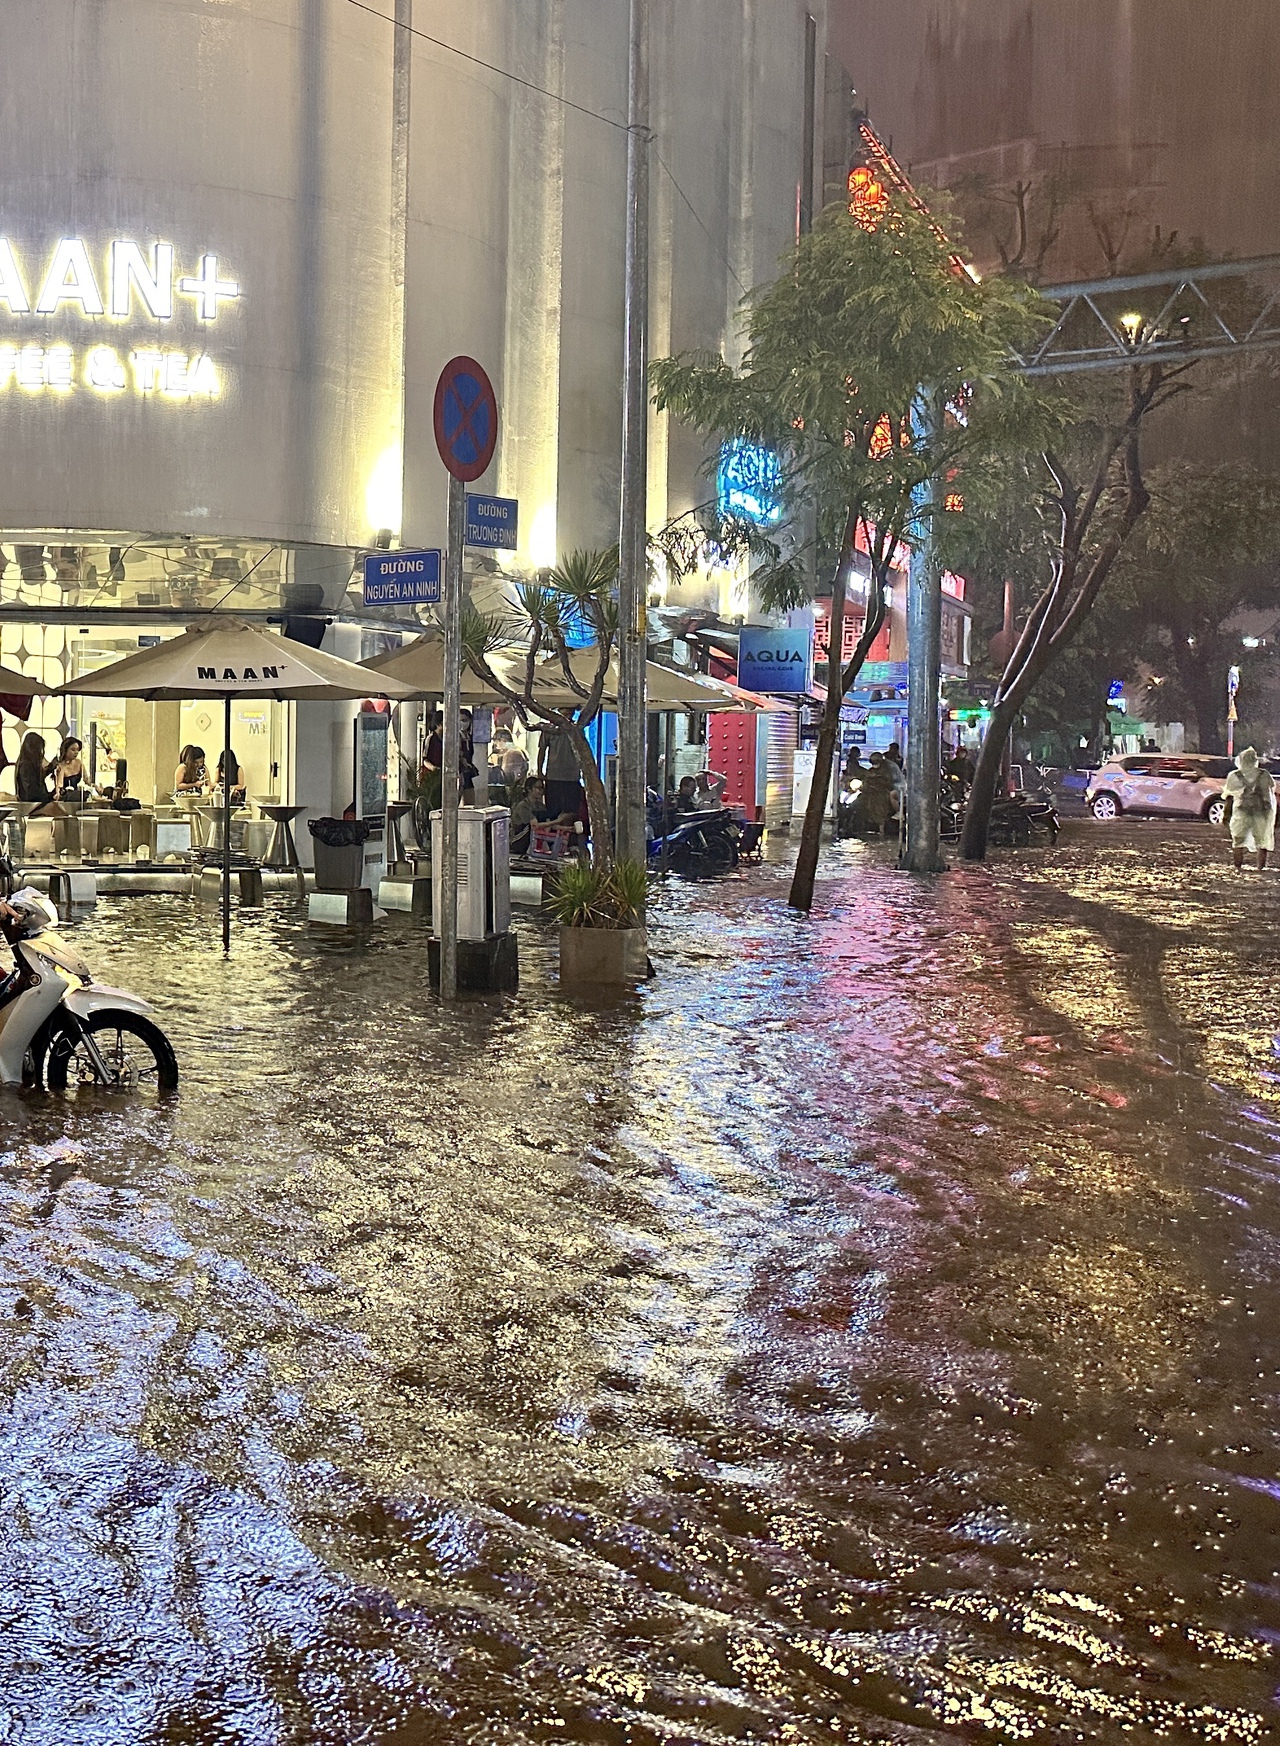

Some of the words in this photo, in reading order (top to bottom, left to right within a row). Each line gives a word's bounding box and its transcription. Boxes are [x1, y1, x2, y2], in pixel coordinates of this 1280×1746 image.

[89, 347, 125, 389] &
[135, 350, 220, 394] TEA
[477, 503, 508, 519] ĐƯỜNG
[468, 523, 498, 542] TRƯƠNG
[380, 559, 424, 575] ĐƯỜNG
[367, 579, 400, 600] NGUYỄN
[402, 583, 414, 598] AN
[416, 581, 437, 597] NINH
[743, 650, 804, 663] AQUA
